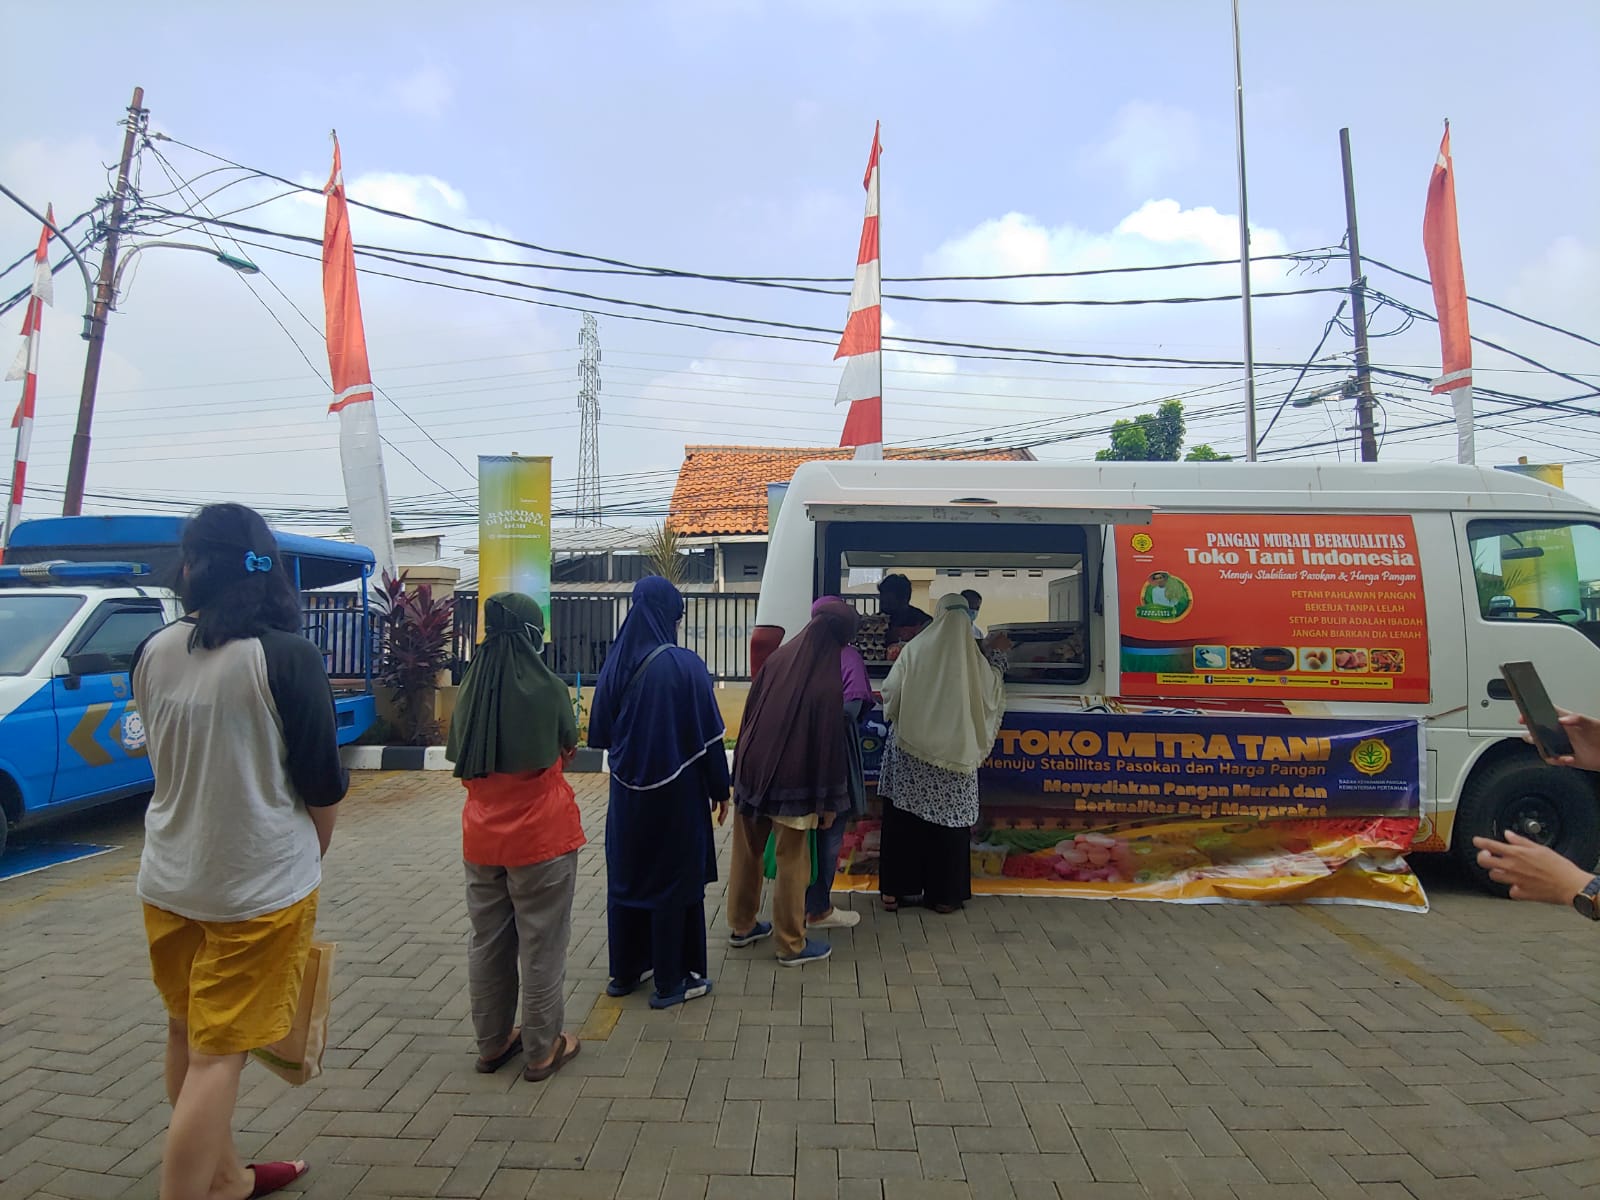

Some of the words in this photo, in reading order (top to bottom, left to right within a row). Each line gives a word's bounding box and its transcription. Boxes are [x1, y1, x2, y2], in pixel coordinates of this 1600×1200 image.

[1206, 532, 1260, 547] PANGAN
[1263, 533, 1312, 548] MURAH
[1314, 533, 1406, 549] BERKUALITAS
[1183, 548, 1239, 564] Toko
[1245, 548, 1295, 565] Tani
[1302, 549, 1416, 567] Indonesia
[1219, 569, 1253, 584] Menuju
[1300, 569, 1336, 582] Pasokan
[1338, 572, 1349, 582] &
[1350, 570, 1379, 586] Harga
[1382, 571, 1416, 586] Pangan
[1291, 590, 1323, 599] PETANI
[1325, 591, 1376, 600] PAHLAWAN
[1378, 591, 1416, 600] PANGAN
[1305, 603, 1342, 612] BEKERJA
[1345, 603, 1375, 612] TANPA
[1377, 604, 1405, 613] LELAH
[1289, 616, 1319, 625] SETIAP
[1321, 616, 1347, 625] BULIR
[1349, 617, 1386, 626] ADALAH
[1388, 618, 1423, 626] IBADAH
[1292, 629, 1328, 638] JANGAN
[1330, 629, 1370, 638] BIARKAN
[1372, 630, 1387, 639] DIA
[1390, 630, 1421, 639] LEMAH
[996, 729, 1102, 757] TOKO
[1108, 731, 1235, 760] MITRA
[1237, 734, 1332, 762] TANI
[981, 758, 1036, 773] Menuju
[1040, 757, 1111, 772] Stabilitas
[1116, 760, 1181, 774] Pasokan
[1185, 761, 1214, 774] dan
[1220, 762, 1265, 778] Harga
[1270, 763, 1326, 777] Pangan
[1043, 779, 1161, 798] Menyediakan
[1164, 781, 1229, 800] Pangan
[1232, 784, 1290, 798] Murah
[1292, 784, 1328, 799] dan
[1074, 799, 1176, 814] Berkualitas
[1178, 801, 1217, 819] Bagi
[1221, 802, 1327, 820] Masyarakat
